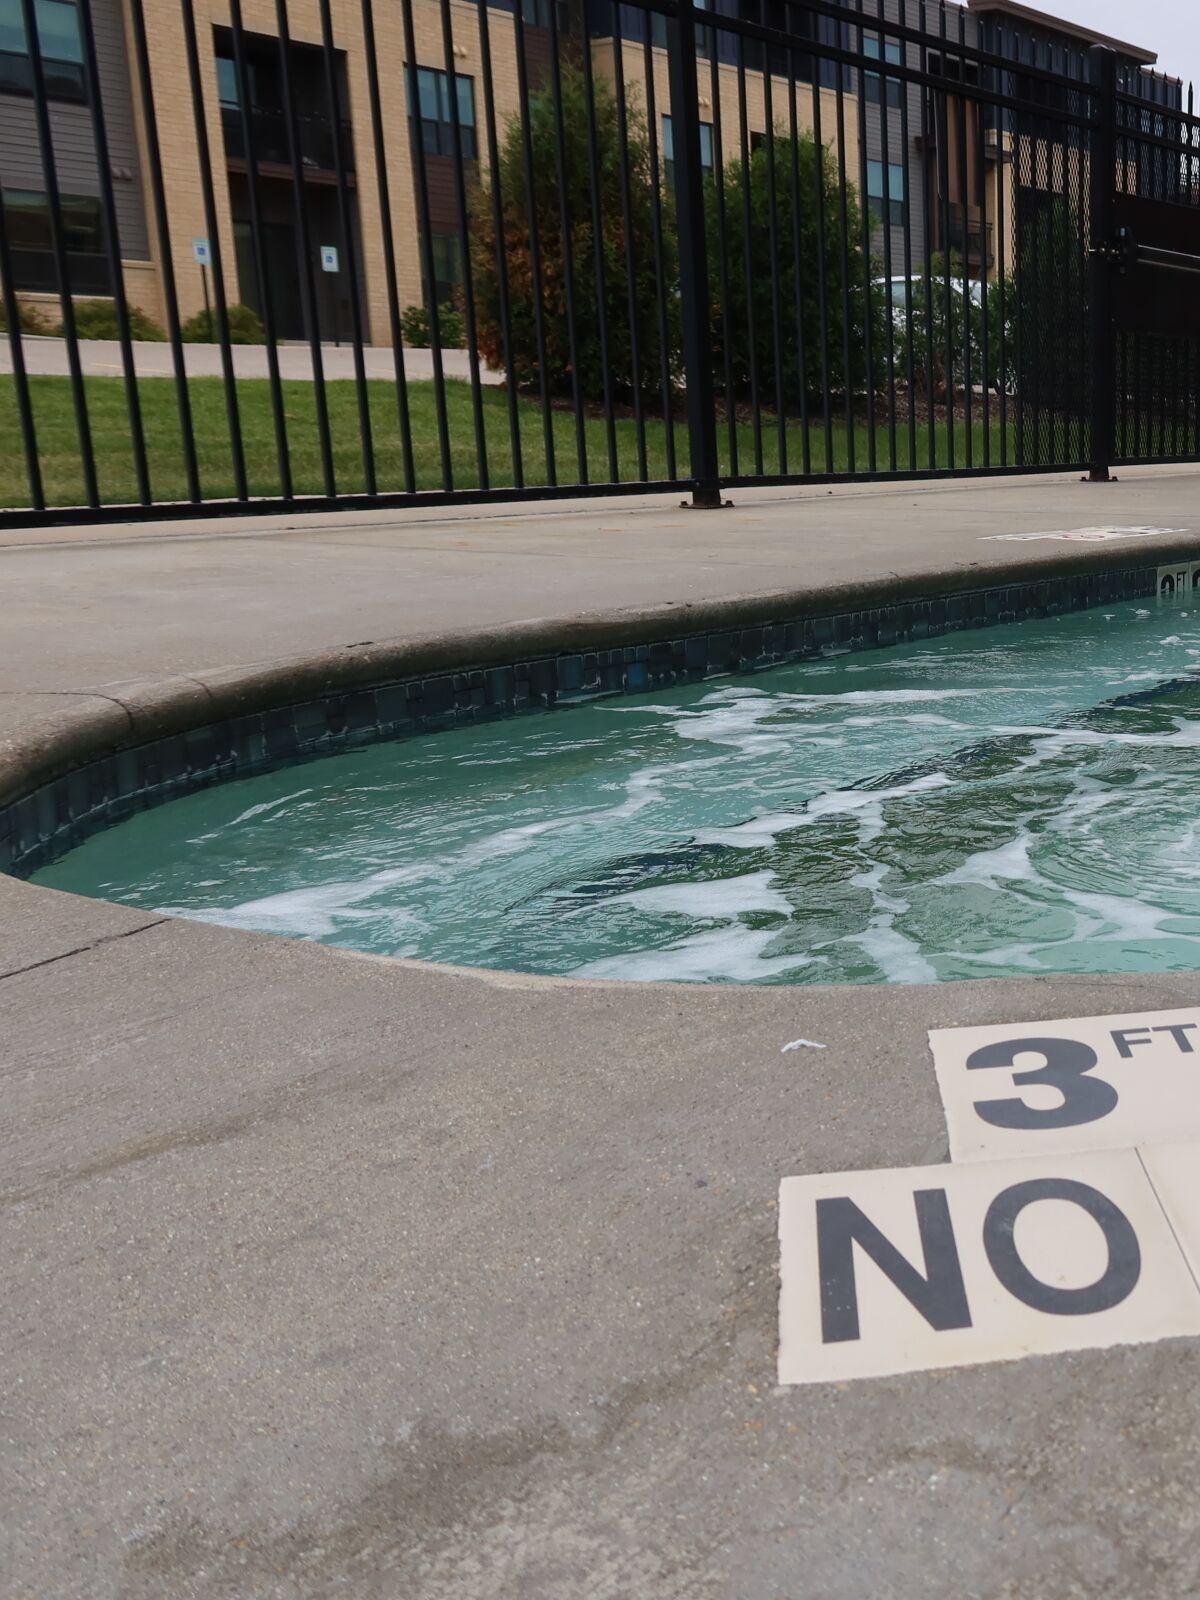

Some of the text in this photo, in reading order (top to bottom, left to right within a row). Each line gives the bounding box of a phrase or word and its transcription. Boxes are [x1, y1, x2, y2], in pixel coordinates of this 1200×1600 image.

[1177, 571, 1187, 588] FT
[965, 1037, 1119, 1130] 3
[1109, 1023, 1198, 1058] FT
[815, 1177, 1142, 1344] NO
